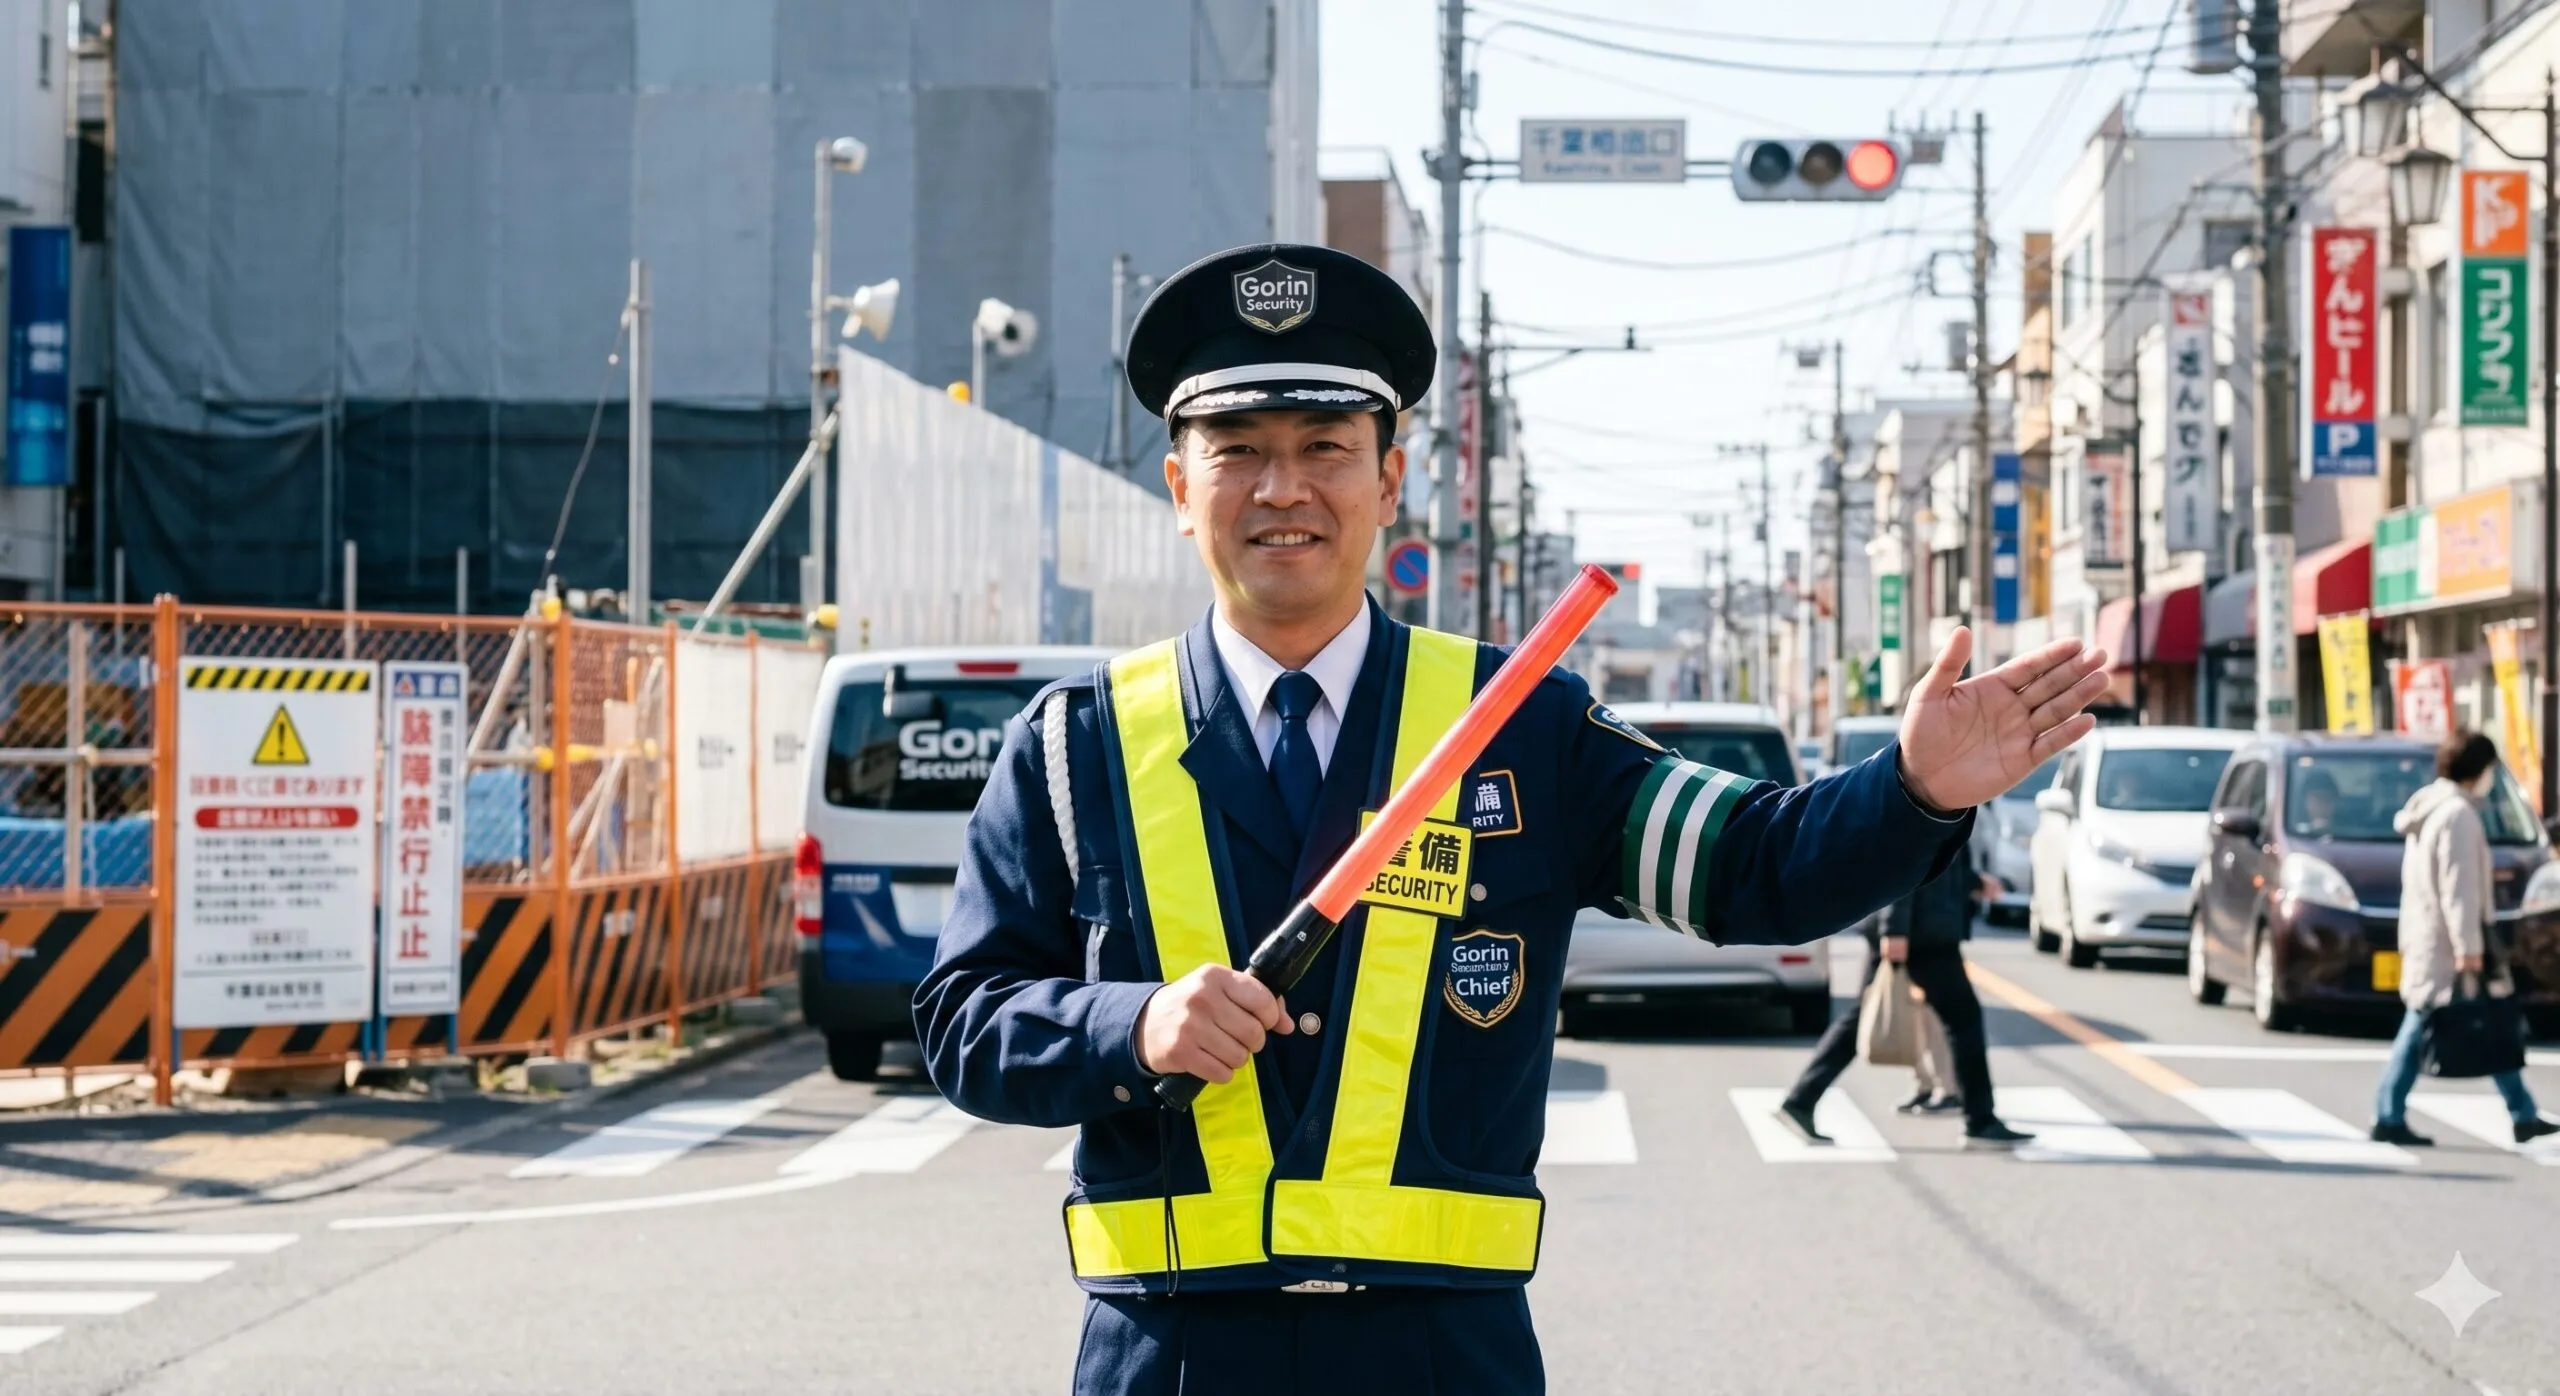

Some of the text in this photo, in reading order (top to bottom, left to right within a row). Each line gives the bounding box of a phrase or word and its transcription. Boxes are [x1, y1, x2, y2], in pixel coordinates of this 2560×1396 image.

[1240, 275, 1308, 297] Gorin
[1246, 297, 1304, 314] Security
[2328, 423, 2360, 457] P
[1472, 813, 1505, 828] RITY
[1452, 943, 1510, 963] Gorin
[1455, 976, 1511, 996] Chief
